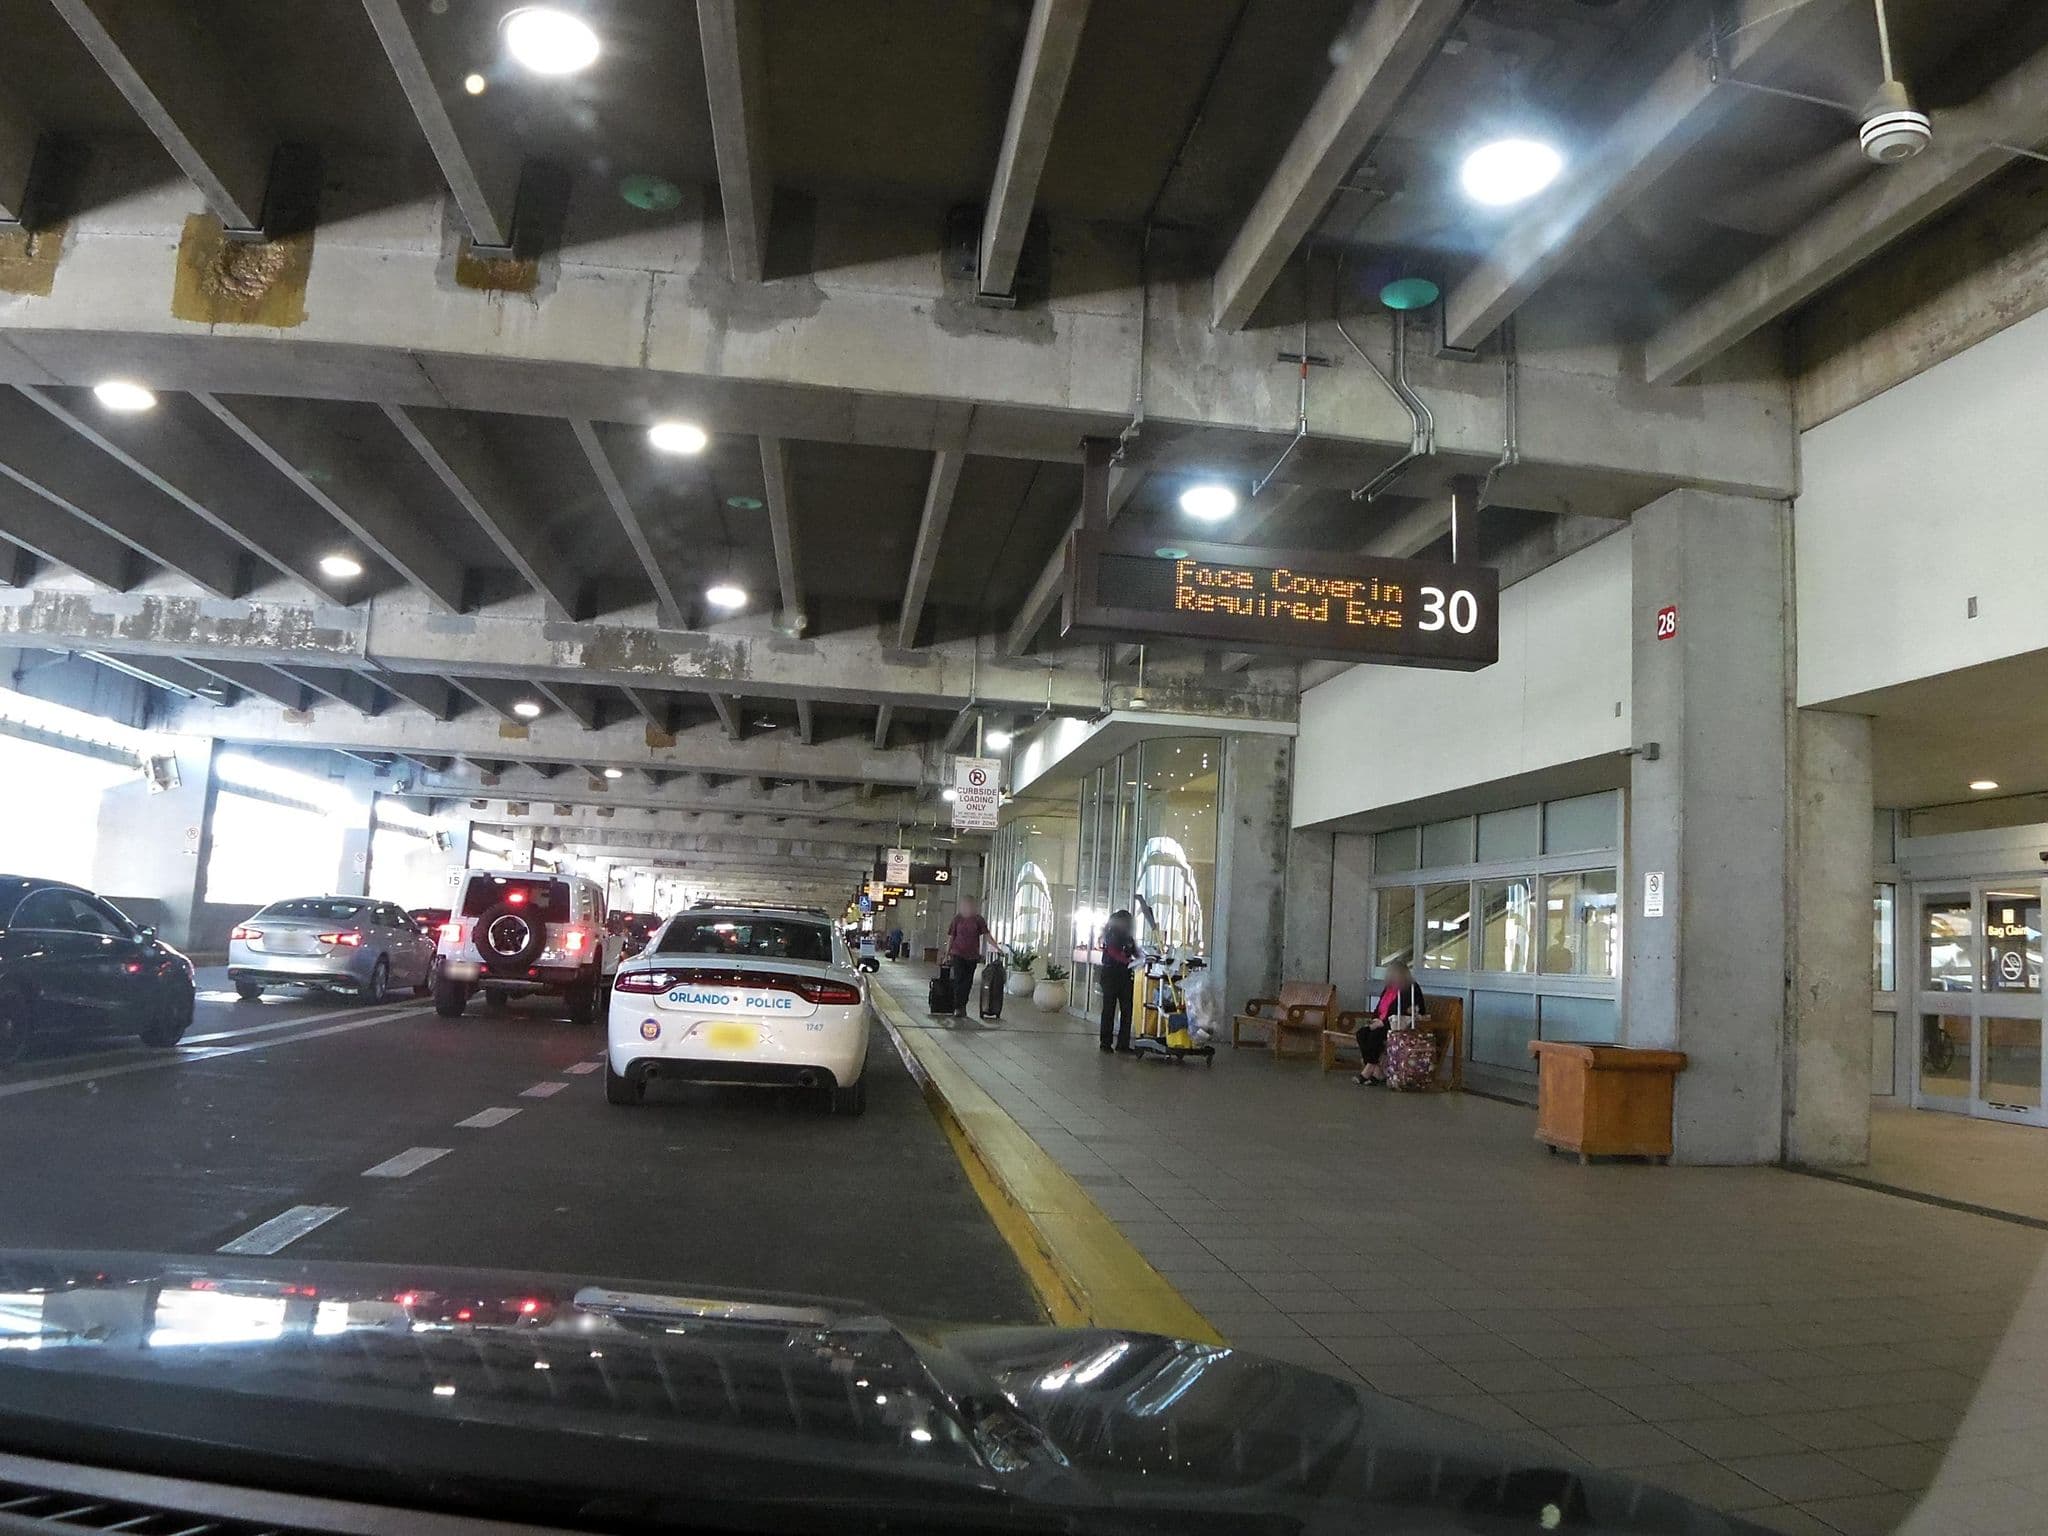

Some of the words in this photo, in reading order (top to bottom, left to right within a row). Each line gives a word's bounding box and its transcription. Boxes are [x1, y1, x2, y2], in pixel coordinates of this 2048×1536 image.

[1175, 559, 1253, 590] Face
[1271, 568, 1403, 604] Coverin
[1175, 586, 1329, 622] Required
[1345, 600, 1403, 629] Eve
[1418, 586, 1479, 635] 30
[1658, 611, 1676, 636] 28
[957, 787, 998, 796] CURBSIDE
[959, 795, 994, 804] LOADING
[966, 803, 986, 811] ONLY
[449, 876, 460, 886] 15
[935, 870, 949, 882] 29
[1988, 925, 2005, 938] Bag
[668, 991, 730, 1006] ORLANDO
[746, 997, 792, 1009] POLICE
